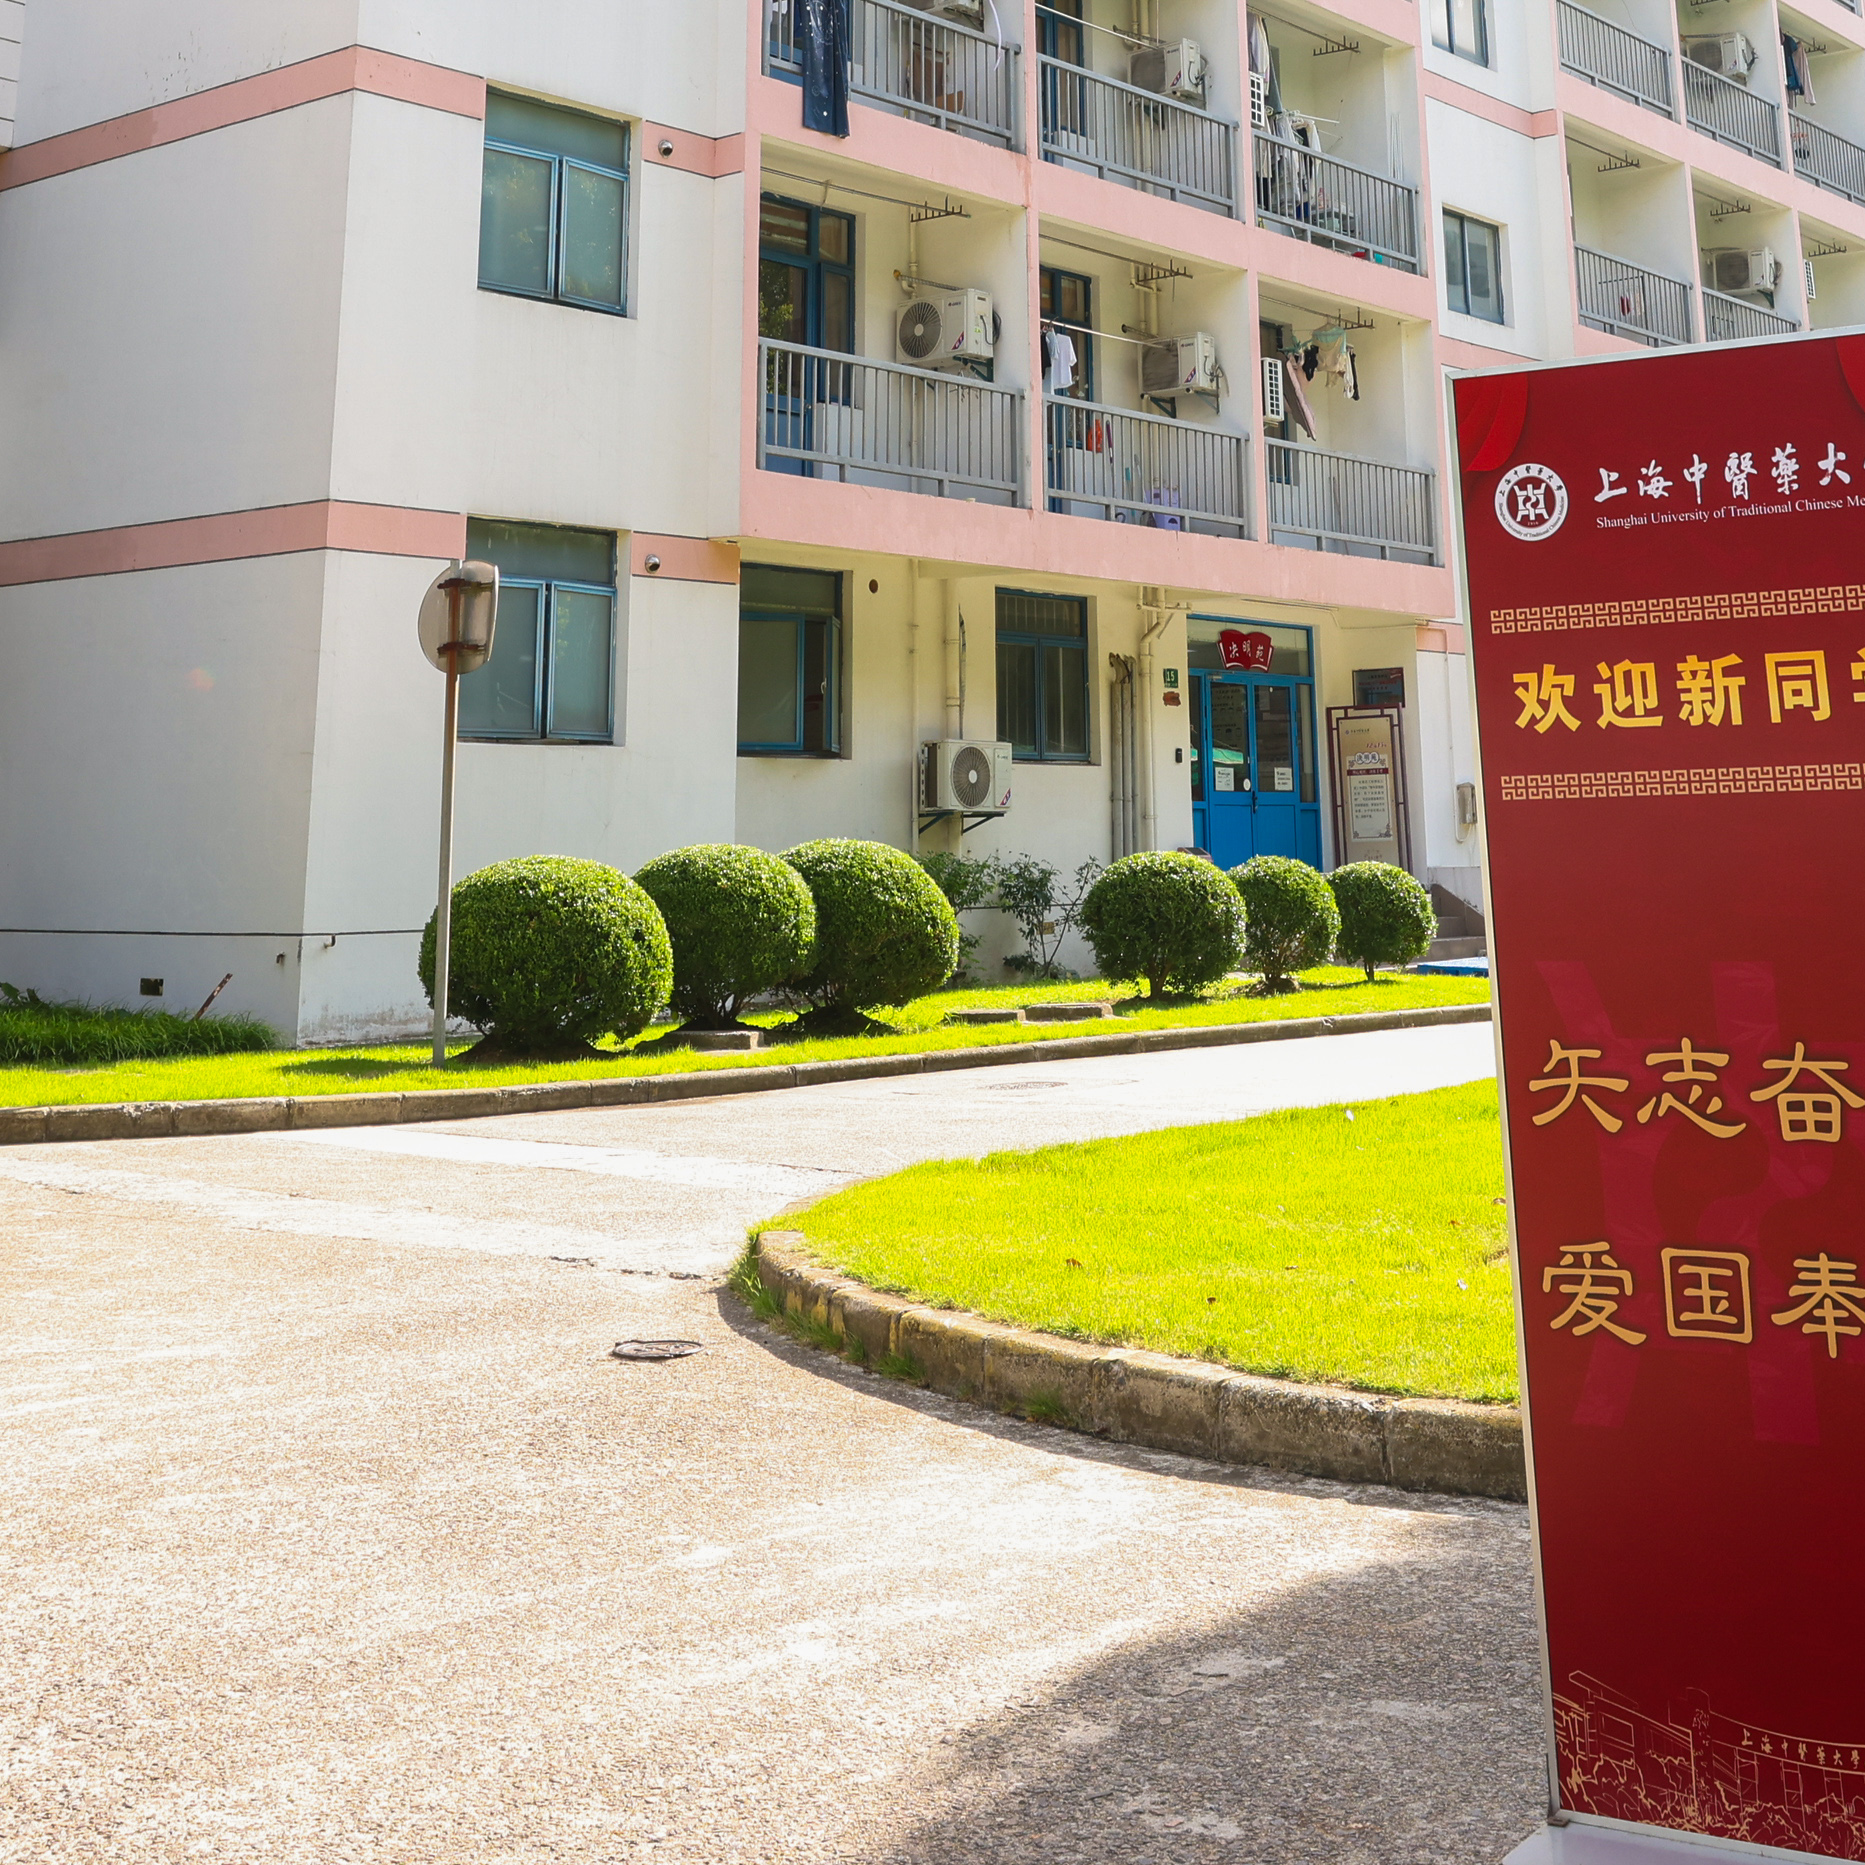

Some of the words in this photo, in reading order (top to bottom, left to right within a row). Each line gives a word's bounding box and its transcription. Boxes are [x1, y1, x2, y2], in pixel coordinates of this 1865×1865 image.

[1596, 512, 1648, 530] Shanghai
[1650, 510, 1710, 525] University
[1713, 506, 1727, 519] of
[1728, 501, 1792, 518] Traditional
[1794, 498, 1844, 512] Chinese
[1166, 670, 1175, 682] 15
